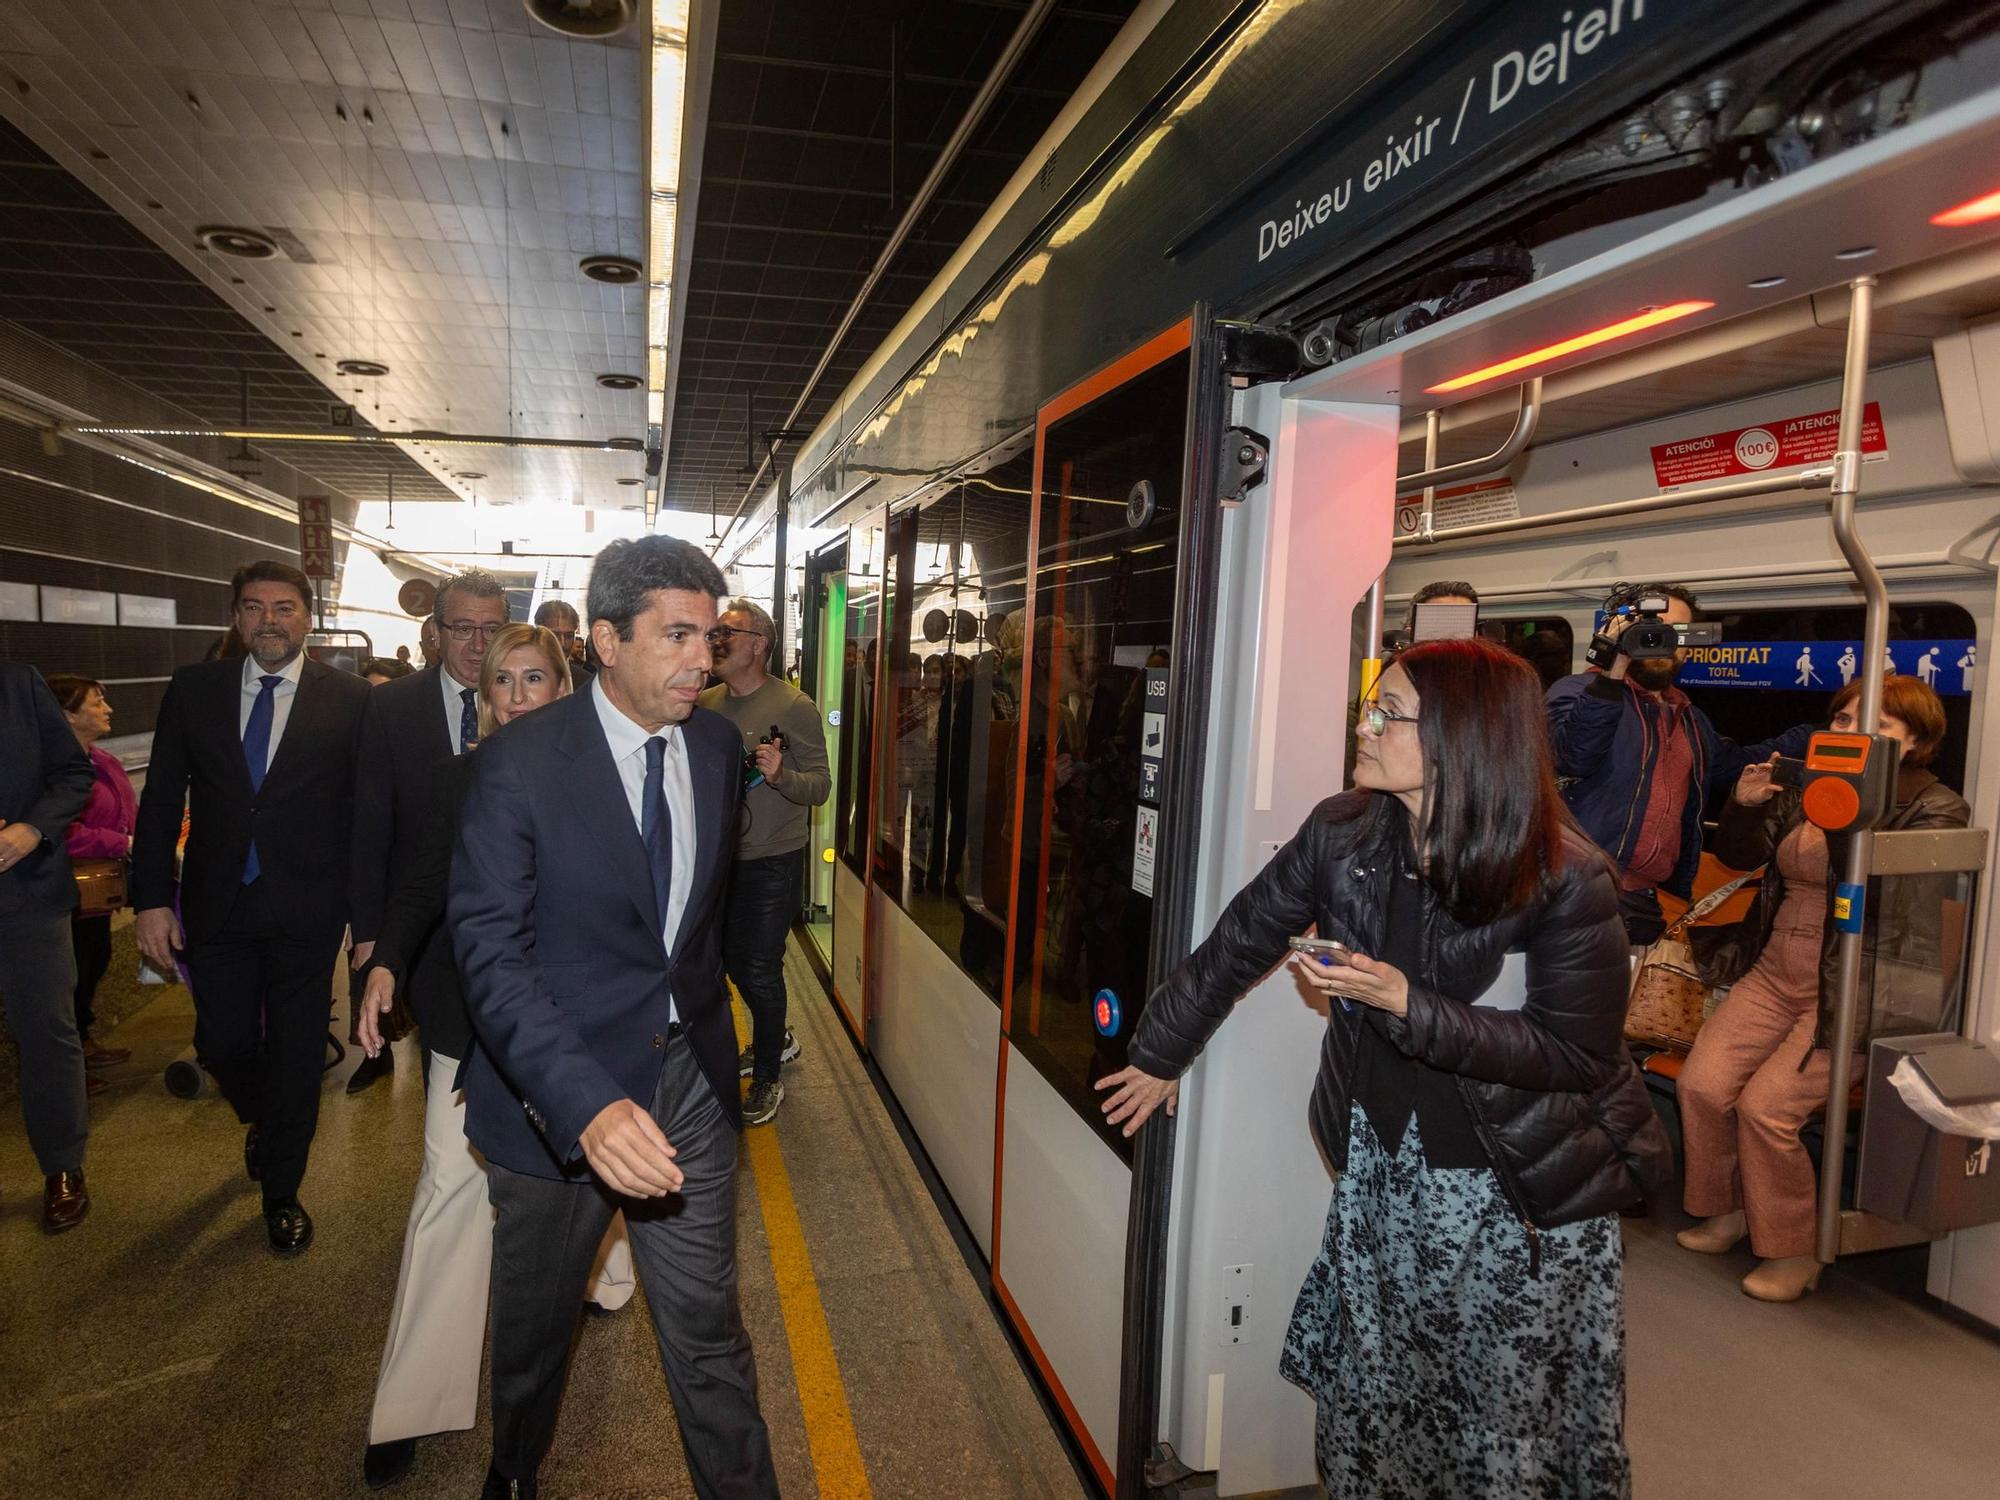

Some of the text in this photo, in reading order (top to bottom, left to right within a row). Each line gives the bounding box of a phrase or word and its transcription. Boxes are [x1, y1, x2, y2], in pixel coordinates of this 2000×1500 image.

[1259, 179, 1352, 262] Deixeu
[1364, 115, 1441, 193] eixir
[1450, 78, 1476, 145] /
[1666, 438, 1715, 456] ATENCIÓ!
[409, 591, 425, 611] 2
[1683, 647, 1772, 664] PRIORITAT
[1708, 667, 1740, 678] TOTAL
[1147, 680, 1166, 697] USB
